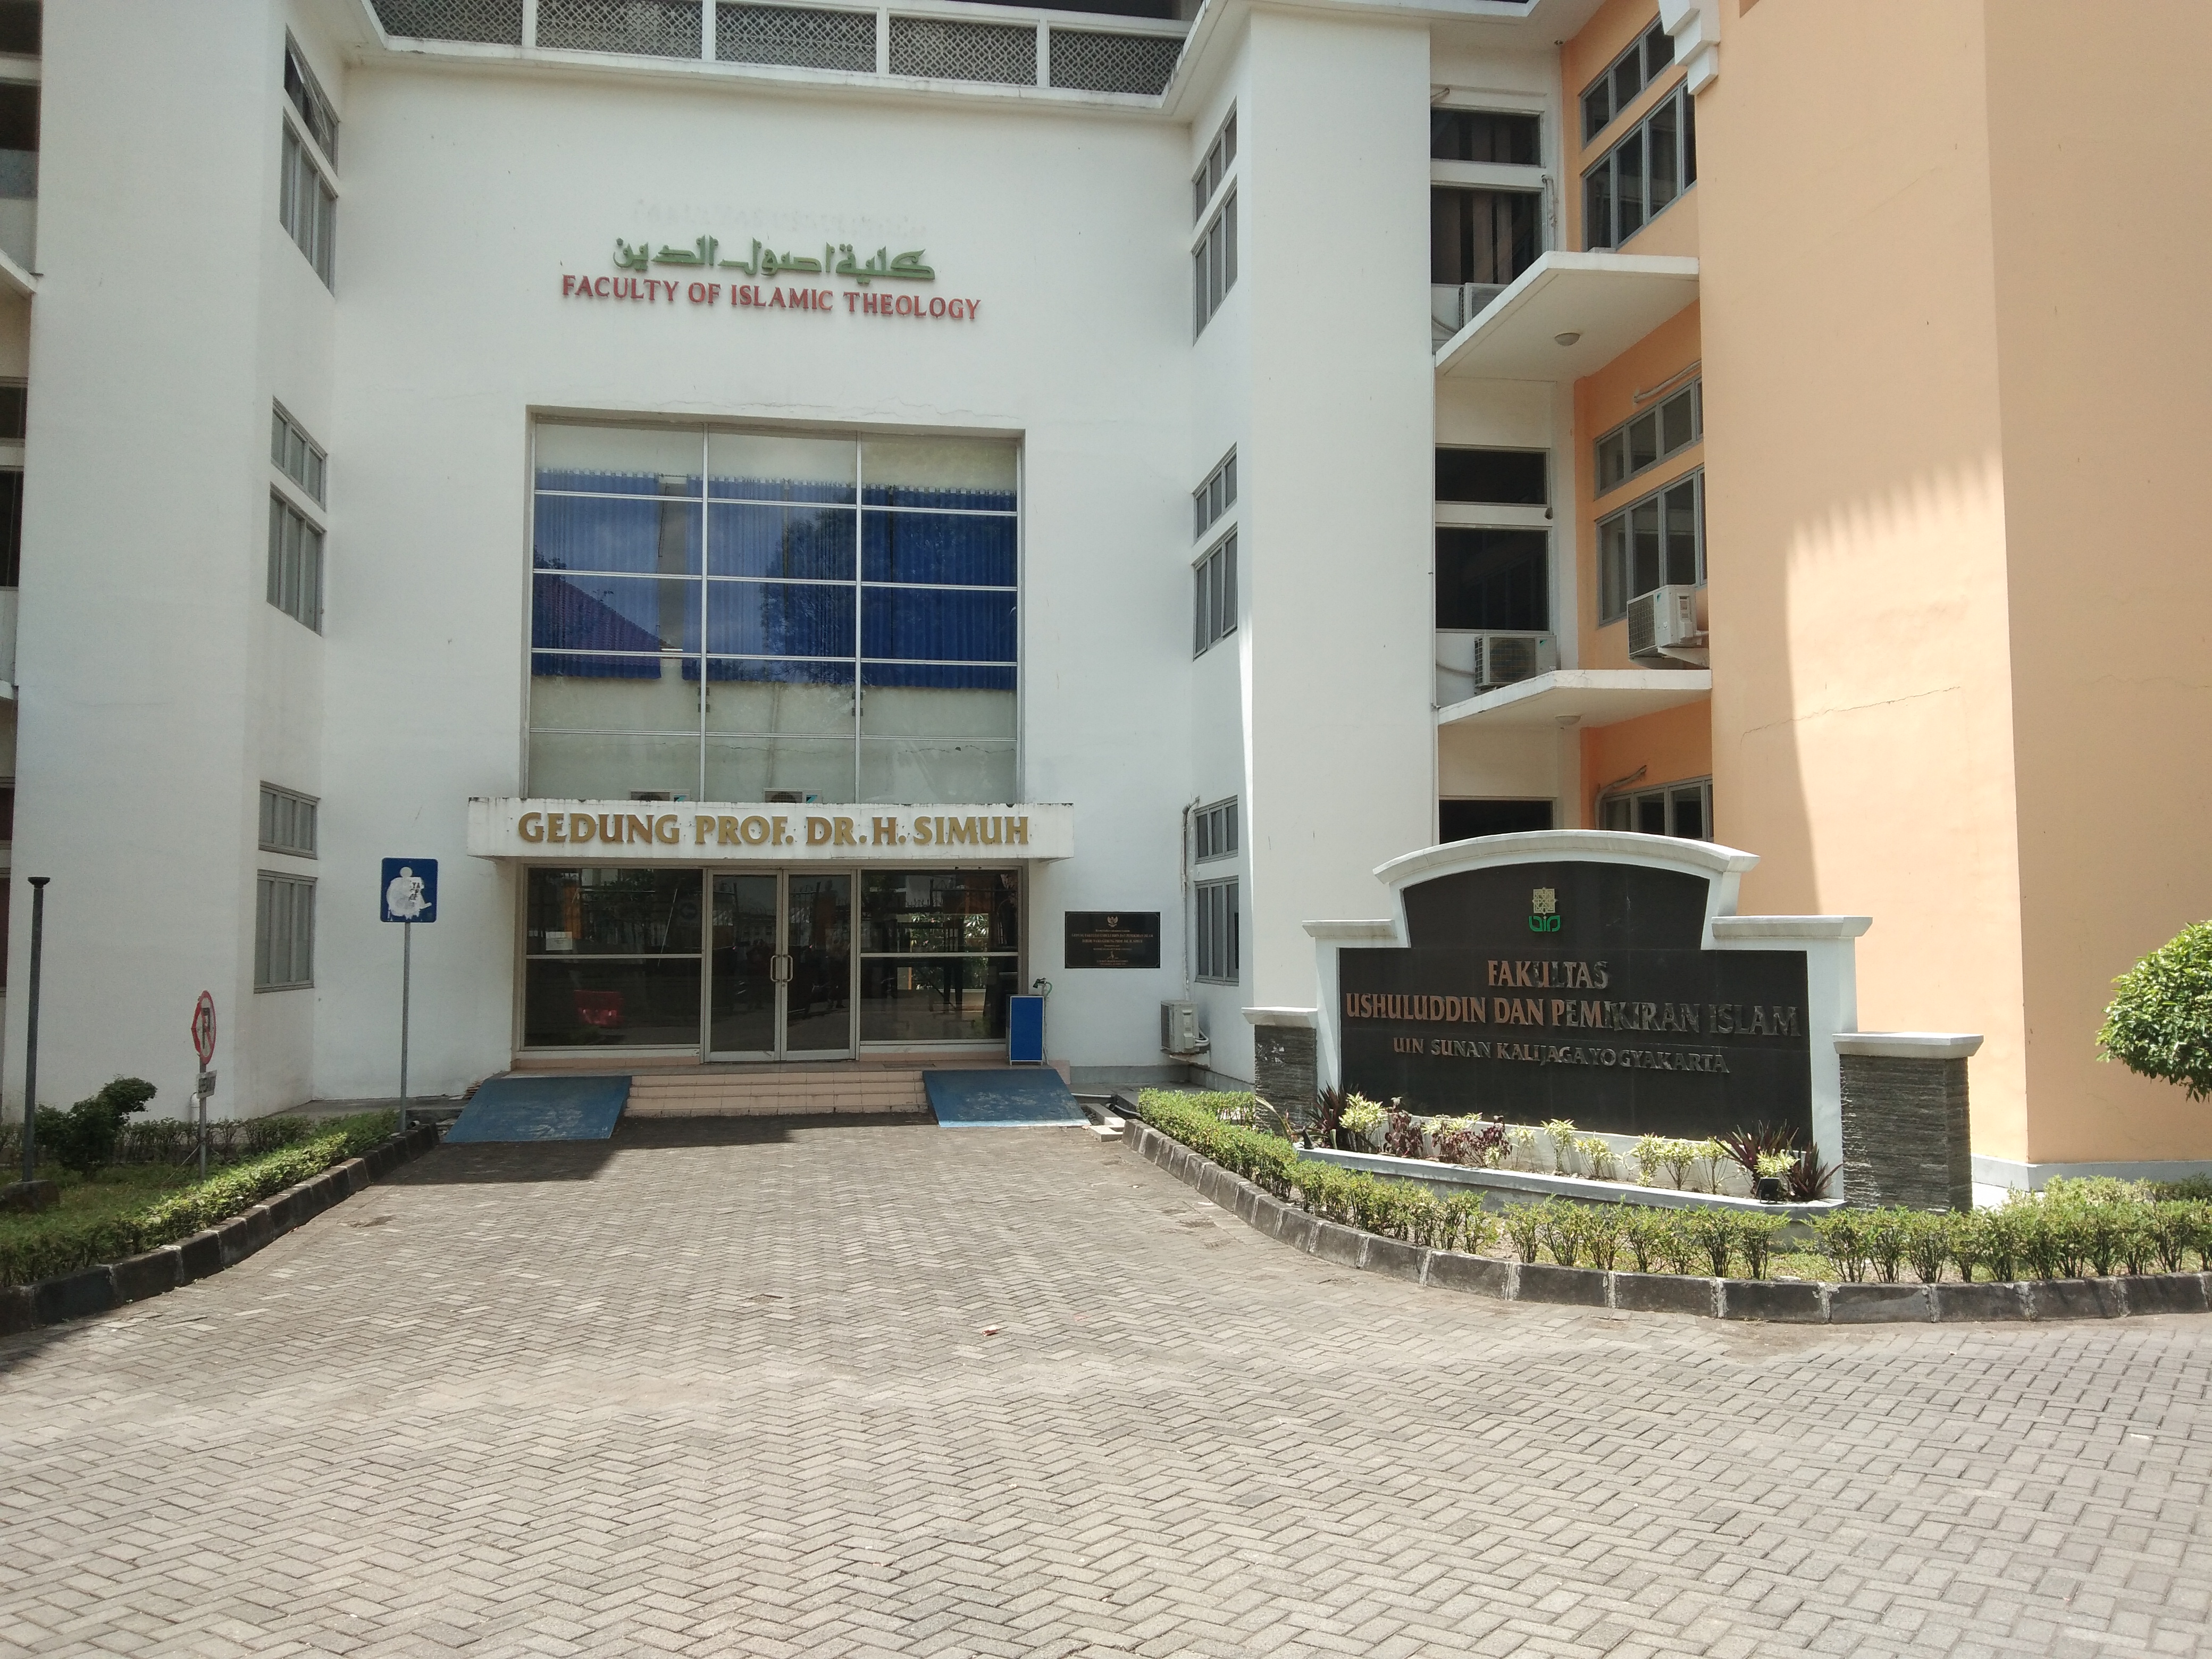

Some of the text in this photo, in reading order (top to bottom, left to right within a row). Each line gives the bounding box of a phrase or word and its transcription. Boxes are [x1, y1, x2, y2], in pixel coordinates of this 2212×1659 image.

[562, 273, 982, 319] FACULTY OF ISLAMIC THEOLOGY
[518, 811, 680, 844] GEDUNG
[694, 815, 794, 845] PROF.
[1487, 960, 1608, 990] FAKULTAS
[1345, 992, 1802, 1036] USHULUDDIN DAN PEMIKIRAN ISLAM
[1393, 1037, 1730, 1074] UIN SUNAN KALIJAGA YOGYAKARTA
